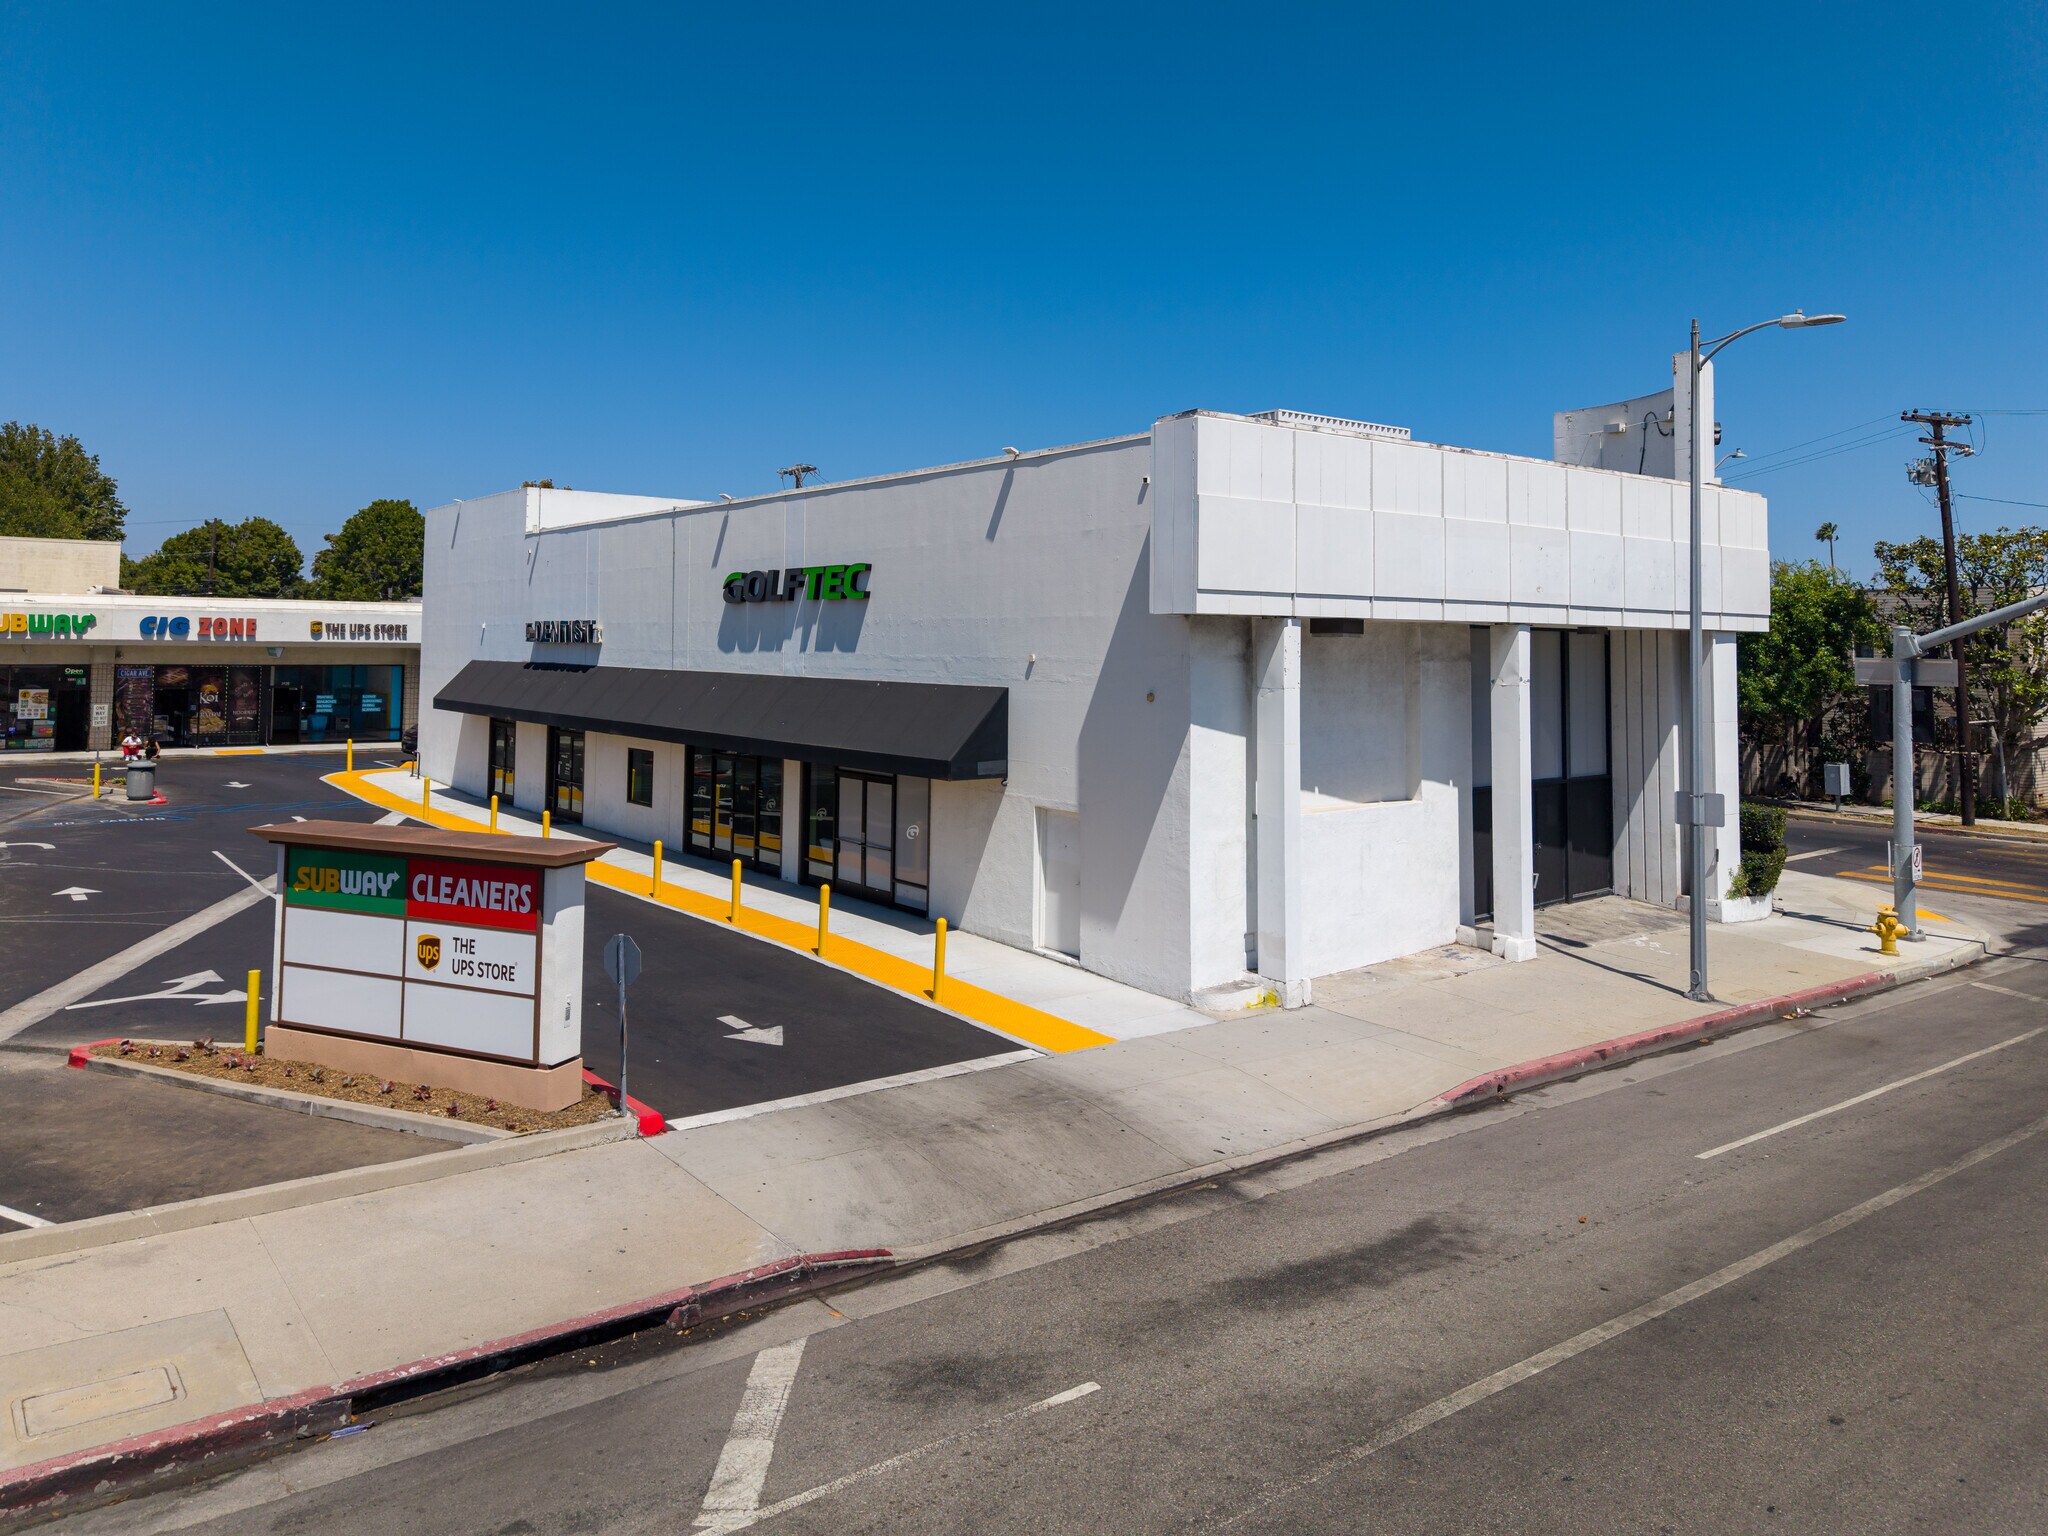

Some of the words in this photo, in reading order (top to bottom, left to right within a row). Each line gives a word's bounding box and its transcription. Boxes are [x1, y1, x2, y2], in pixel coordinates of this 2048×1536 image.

[723, 563, 872, 603] GOLFTEC
[139, 616, 190, 635] CIG
[198, 617, 256, 636] ZONE
[325, 623, 346, 633] THE
[349, 624, 371, 634] UPS
[373, 624, 408, 634] STORE
[533, 620, 598, 643] DENTIST
[64, 667, 84, 675] Open
[200, 692, 219, 704] Koi
[100, 816, 166, 824] PARKING
[293, 866, 400, 898] SUBWAY
[412, 873, 532, 914] CLEANERS
[418, 944, 439, 965] ups
[453, 936, 476, 955] THE
[452, 958, 475, 977] UPS
[477, 961, 516, 982] STORE
